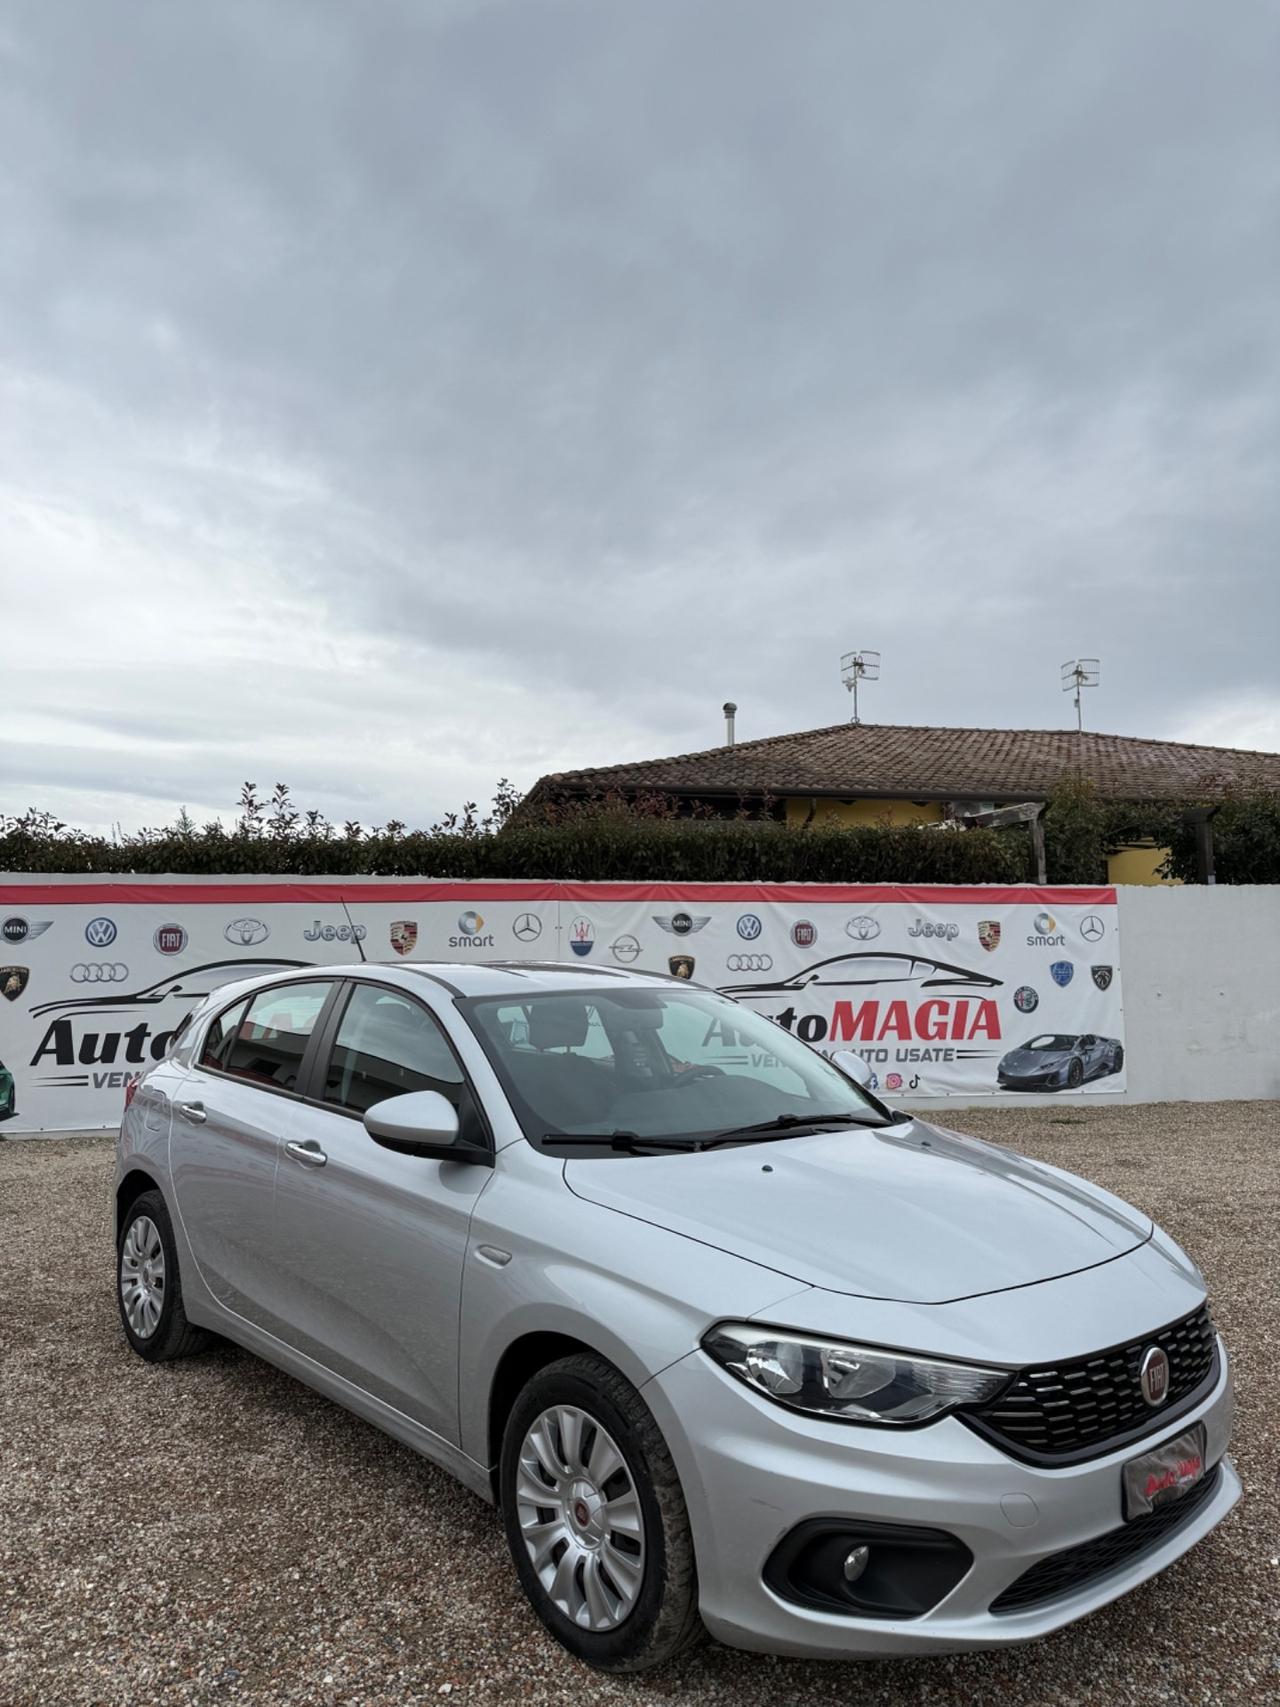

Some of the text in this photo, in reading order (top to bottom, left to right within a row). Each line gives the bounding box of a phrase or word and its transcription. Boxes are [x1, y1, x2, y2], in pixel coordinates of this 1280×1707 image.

[4, 925, 27, 934] MINI
[303, 920, 367, 944] Jeep
[908, 918, 960, 941] Jeep
[161, 932, 182, 948] FIAT
[448, 934, 495, 948] smart
[1026, 934, 1066, 947] smart
[895, 1048, 956, 1063] USATE
[1149, 1362, 1165, 1393] FIAT
